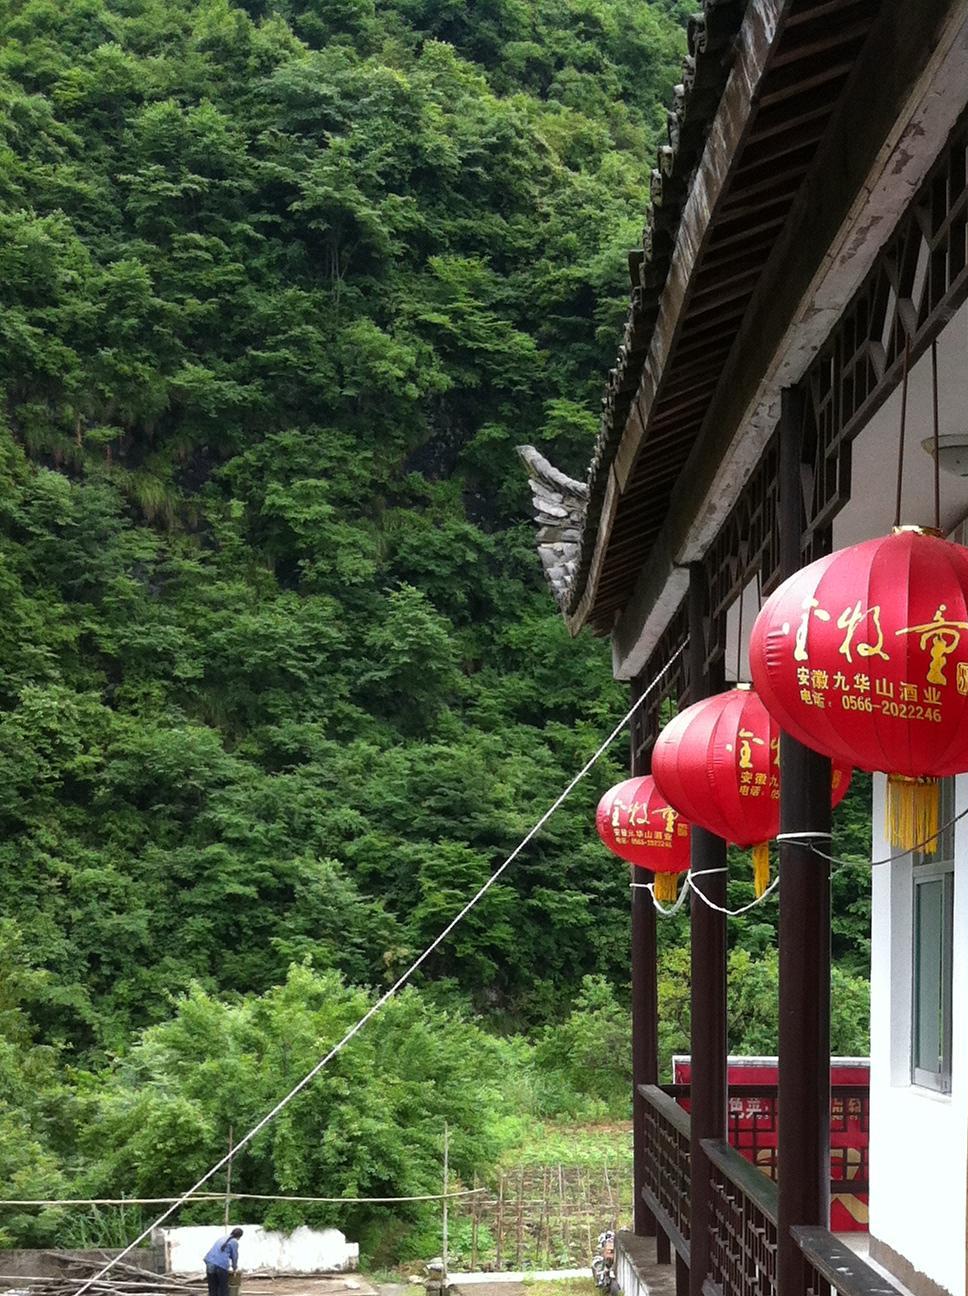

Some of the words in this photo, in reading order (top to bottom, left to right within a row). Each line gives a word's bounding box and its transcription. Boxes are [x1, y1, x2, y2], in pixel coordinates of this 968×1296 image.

[796, 665, 943, 706] 安徽九华山酒业
